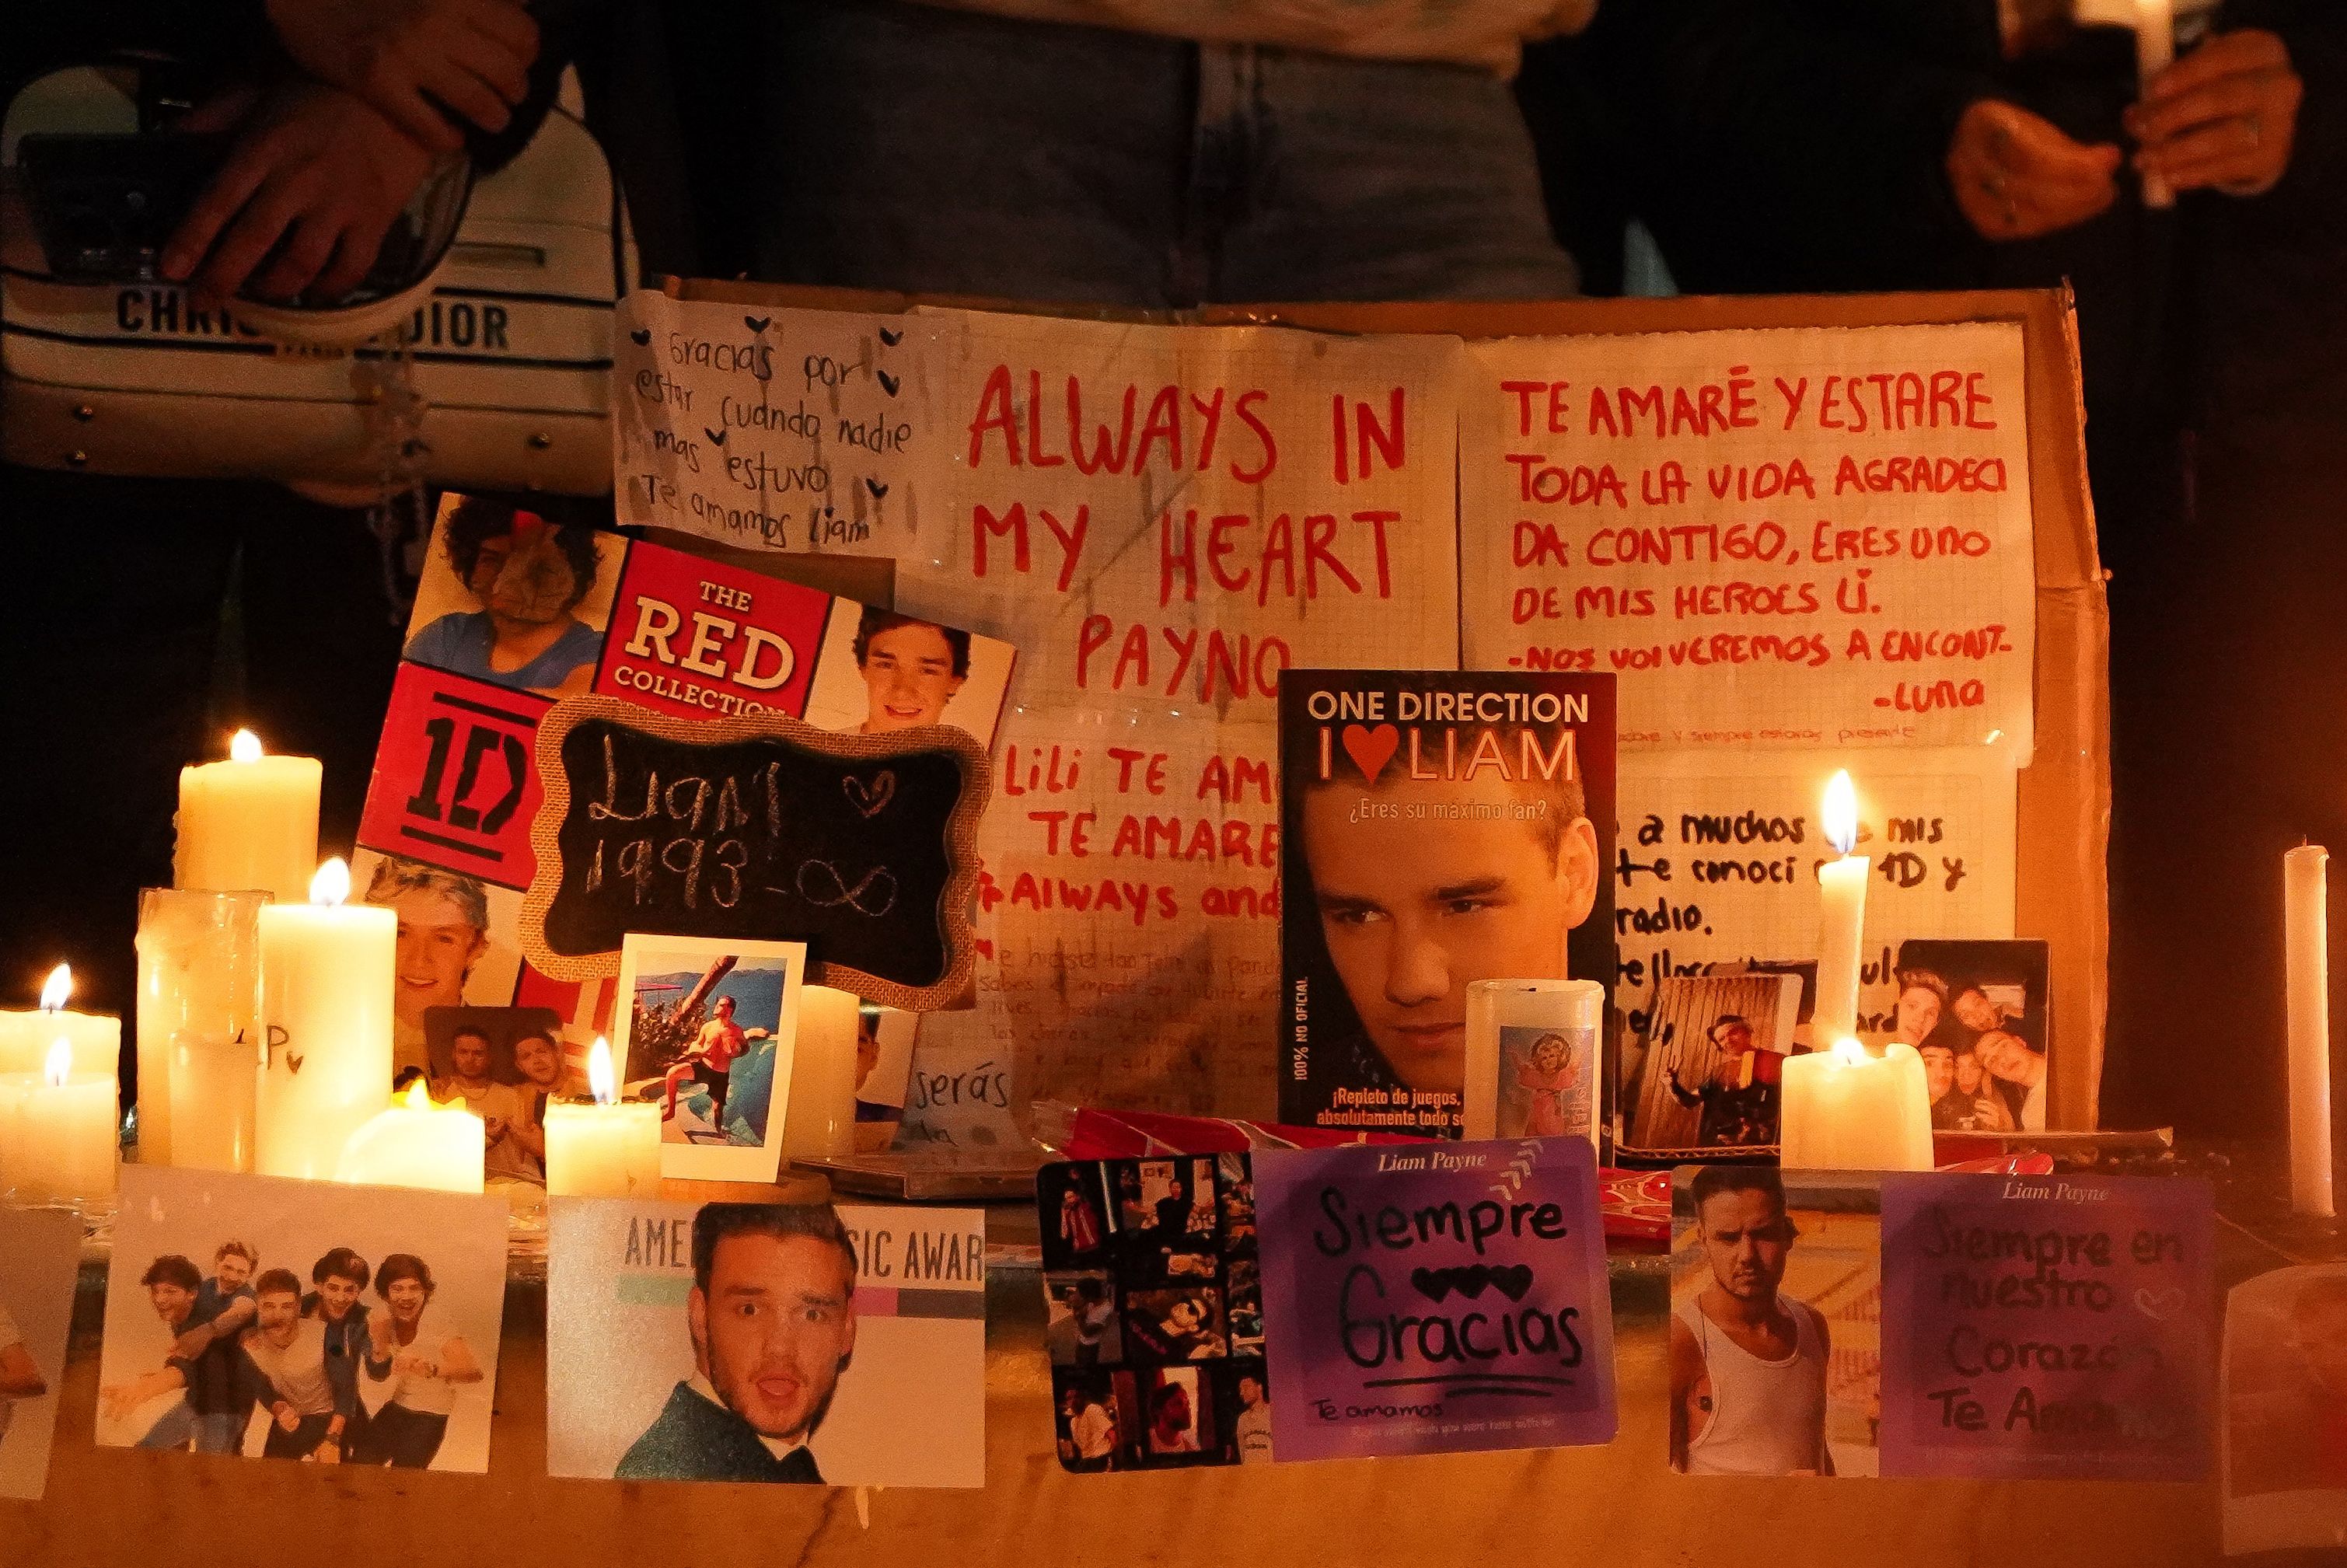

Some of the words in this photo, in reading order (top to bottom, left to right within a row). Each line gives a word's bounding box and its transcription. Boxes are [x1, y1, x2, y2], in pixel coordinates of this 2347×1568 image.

[670, 333, 775, 382] Gracias
[804, 354, 866, 393] por
[636, 369, 694, 411] estar
[838, 413, 911, 454] nadie
[968, 364, 1277, 484] ALWAYS
[1332, 386, 1406, 485] IN
[1500, 381, 1570, 437] TE
[1589, 365, 1759, 438] AMARÉ
[1775, 375, 1808, 431] Y
[1820, 371, 1998, 431] ESTARE
[654, 429, 700, 473] mas
[727, 451, 831, 493] estuvo
[1505, 454, 1627, 508] TODA
[1642, 461, 1692, 505] LA
[1708, 458, 1815, 501] VIDA
[642, 474, 676, 511] Te
[691, 491, 791, 547] amamos
[972, 502, 1089, 592] MY
[1159, 508, 1402, 607] HEART
[1513, 521, 1569, 567] DA
[1812, 520, 1901, 563] ERES
[700, 581, 753, 612] THE
[1513, 586, 1562, 624] DE
[1575, 586, 1655, 620] MIS
[1675, 581, 1819, 620] HEROES
[624, 595, 795, 690] RED
[1077, 615, 1292, 702] PAYNO
[1846, 629, 1872, 661] A
[1308, 691, 1384, 720] ONE
[1399, 692, 1588, 723] DIRECTION
[1108, 748, 1168, 794] TE
[1198, 755, 1277, 804] AM
[1319, 725, 1332, 781] I
[1409, 727, 1577, 781] LIAM
[1350, 797, 1399, 824] ¿Eres
[1406, 802, 1427, 819] su
[1508, 798, 1547, 820] fan?
[1638, 814, 1664, 847] a
[1682, 810, 1805, 843] muchos
[1888, 817, 1944, 844] mis
[1029, 812, 1098, 857] TE
[1112, 815, 1279, 868] AMARE
[1616, 848, 1671, 887] te
[1295, 976, 1308, 1021] OFICIAL
[1295, 1025, 1308, 1042] NO
[916, 1060, 1008, 1109] serás
[1294, 1046, 1308, 1081] 100%
[1317, 1109, 1416, 1126] absolutamente
[1420, 1110, 1448, 1126] todo
[1392, 1088, 1408, 1104] de
[1378, 1154, 1426, 1173] Liam
[1432, 1151, 1486, 1172] Payne
[2002, 1181, 2050, 1200] Liam
[2055, 1183, 2111, 1205] Payne
[1313, 1186, 1567, 1256] Siempre
[1923, 1204, 2112, 1276] Siempre
[2130, 1228, 2184, 1264] en
[849, 1228, 892, 1277] SIC
[903, 1231, 983, 1283] AWAR
[1940, 1269, 2115, 1312] nuestro
[1339, 1263, 1583, 1368] Gracias
[1312, 1398, 1339, 1421] Te
[1346, 1402, 1444, 1419] amamos
[1927, 1387, 1988, 1431] Te
